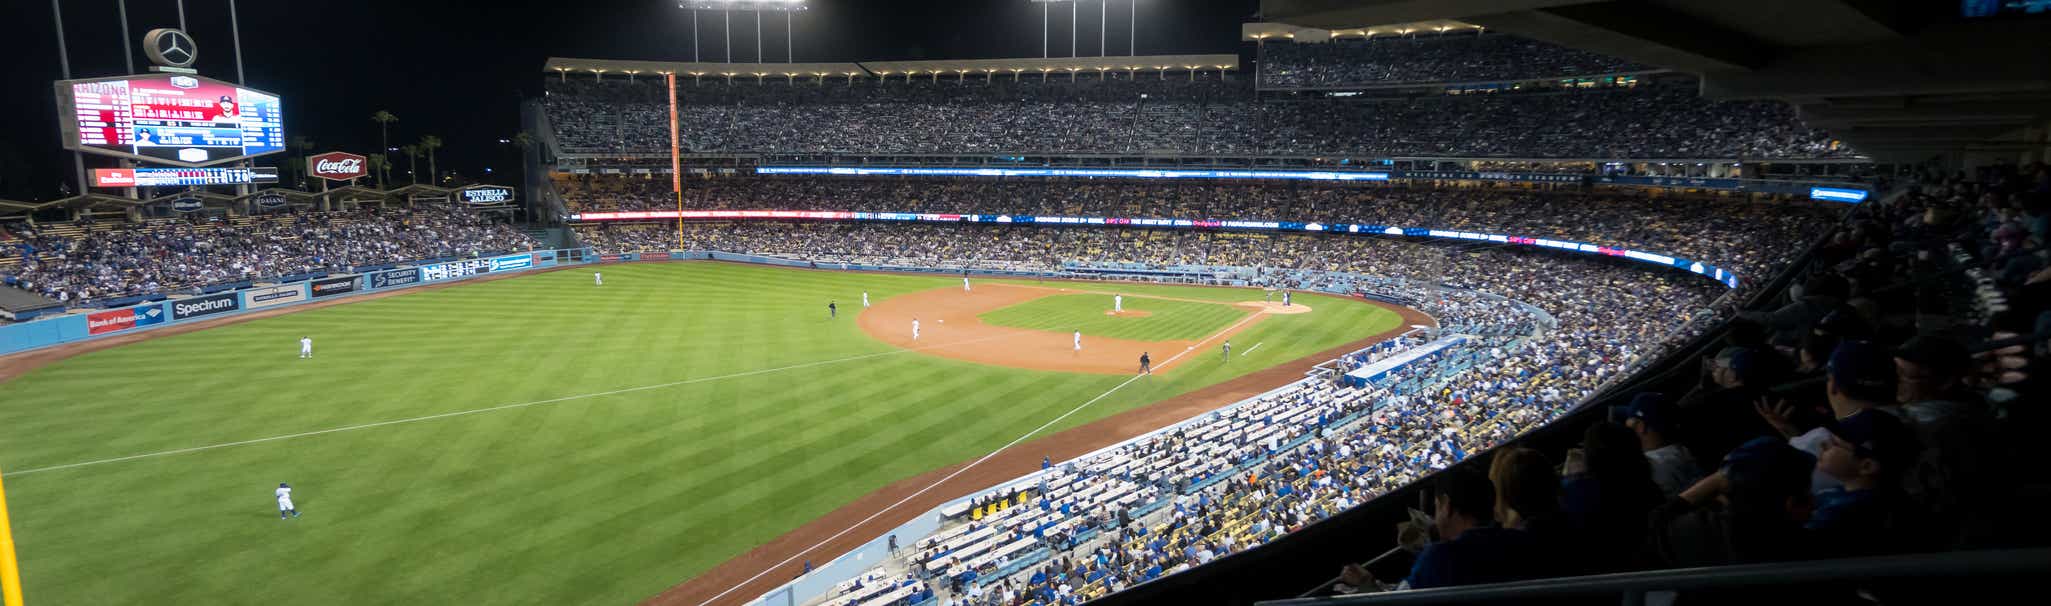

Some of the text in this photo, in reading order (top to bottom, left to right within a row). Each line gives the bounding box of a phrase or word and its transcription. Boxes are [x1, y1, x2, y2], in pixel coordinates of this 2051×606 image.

[73, 82, 128, 97] ARIZONA
[465, 188, 508, 197] ESTRELLA
[469, 195, 505, 203] JALISCO
[387, 269, 417, 280] SECURITY
[175, 298, 232, 316] Spectrum
[89, 313, 146, 329] Bank of America
